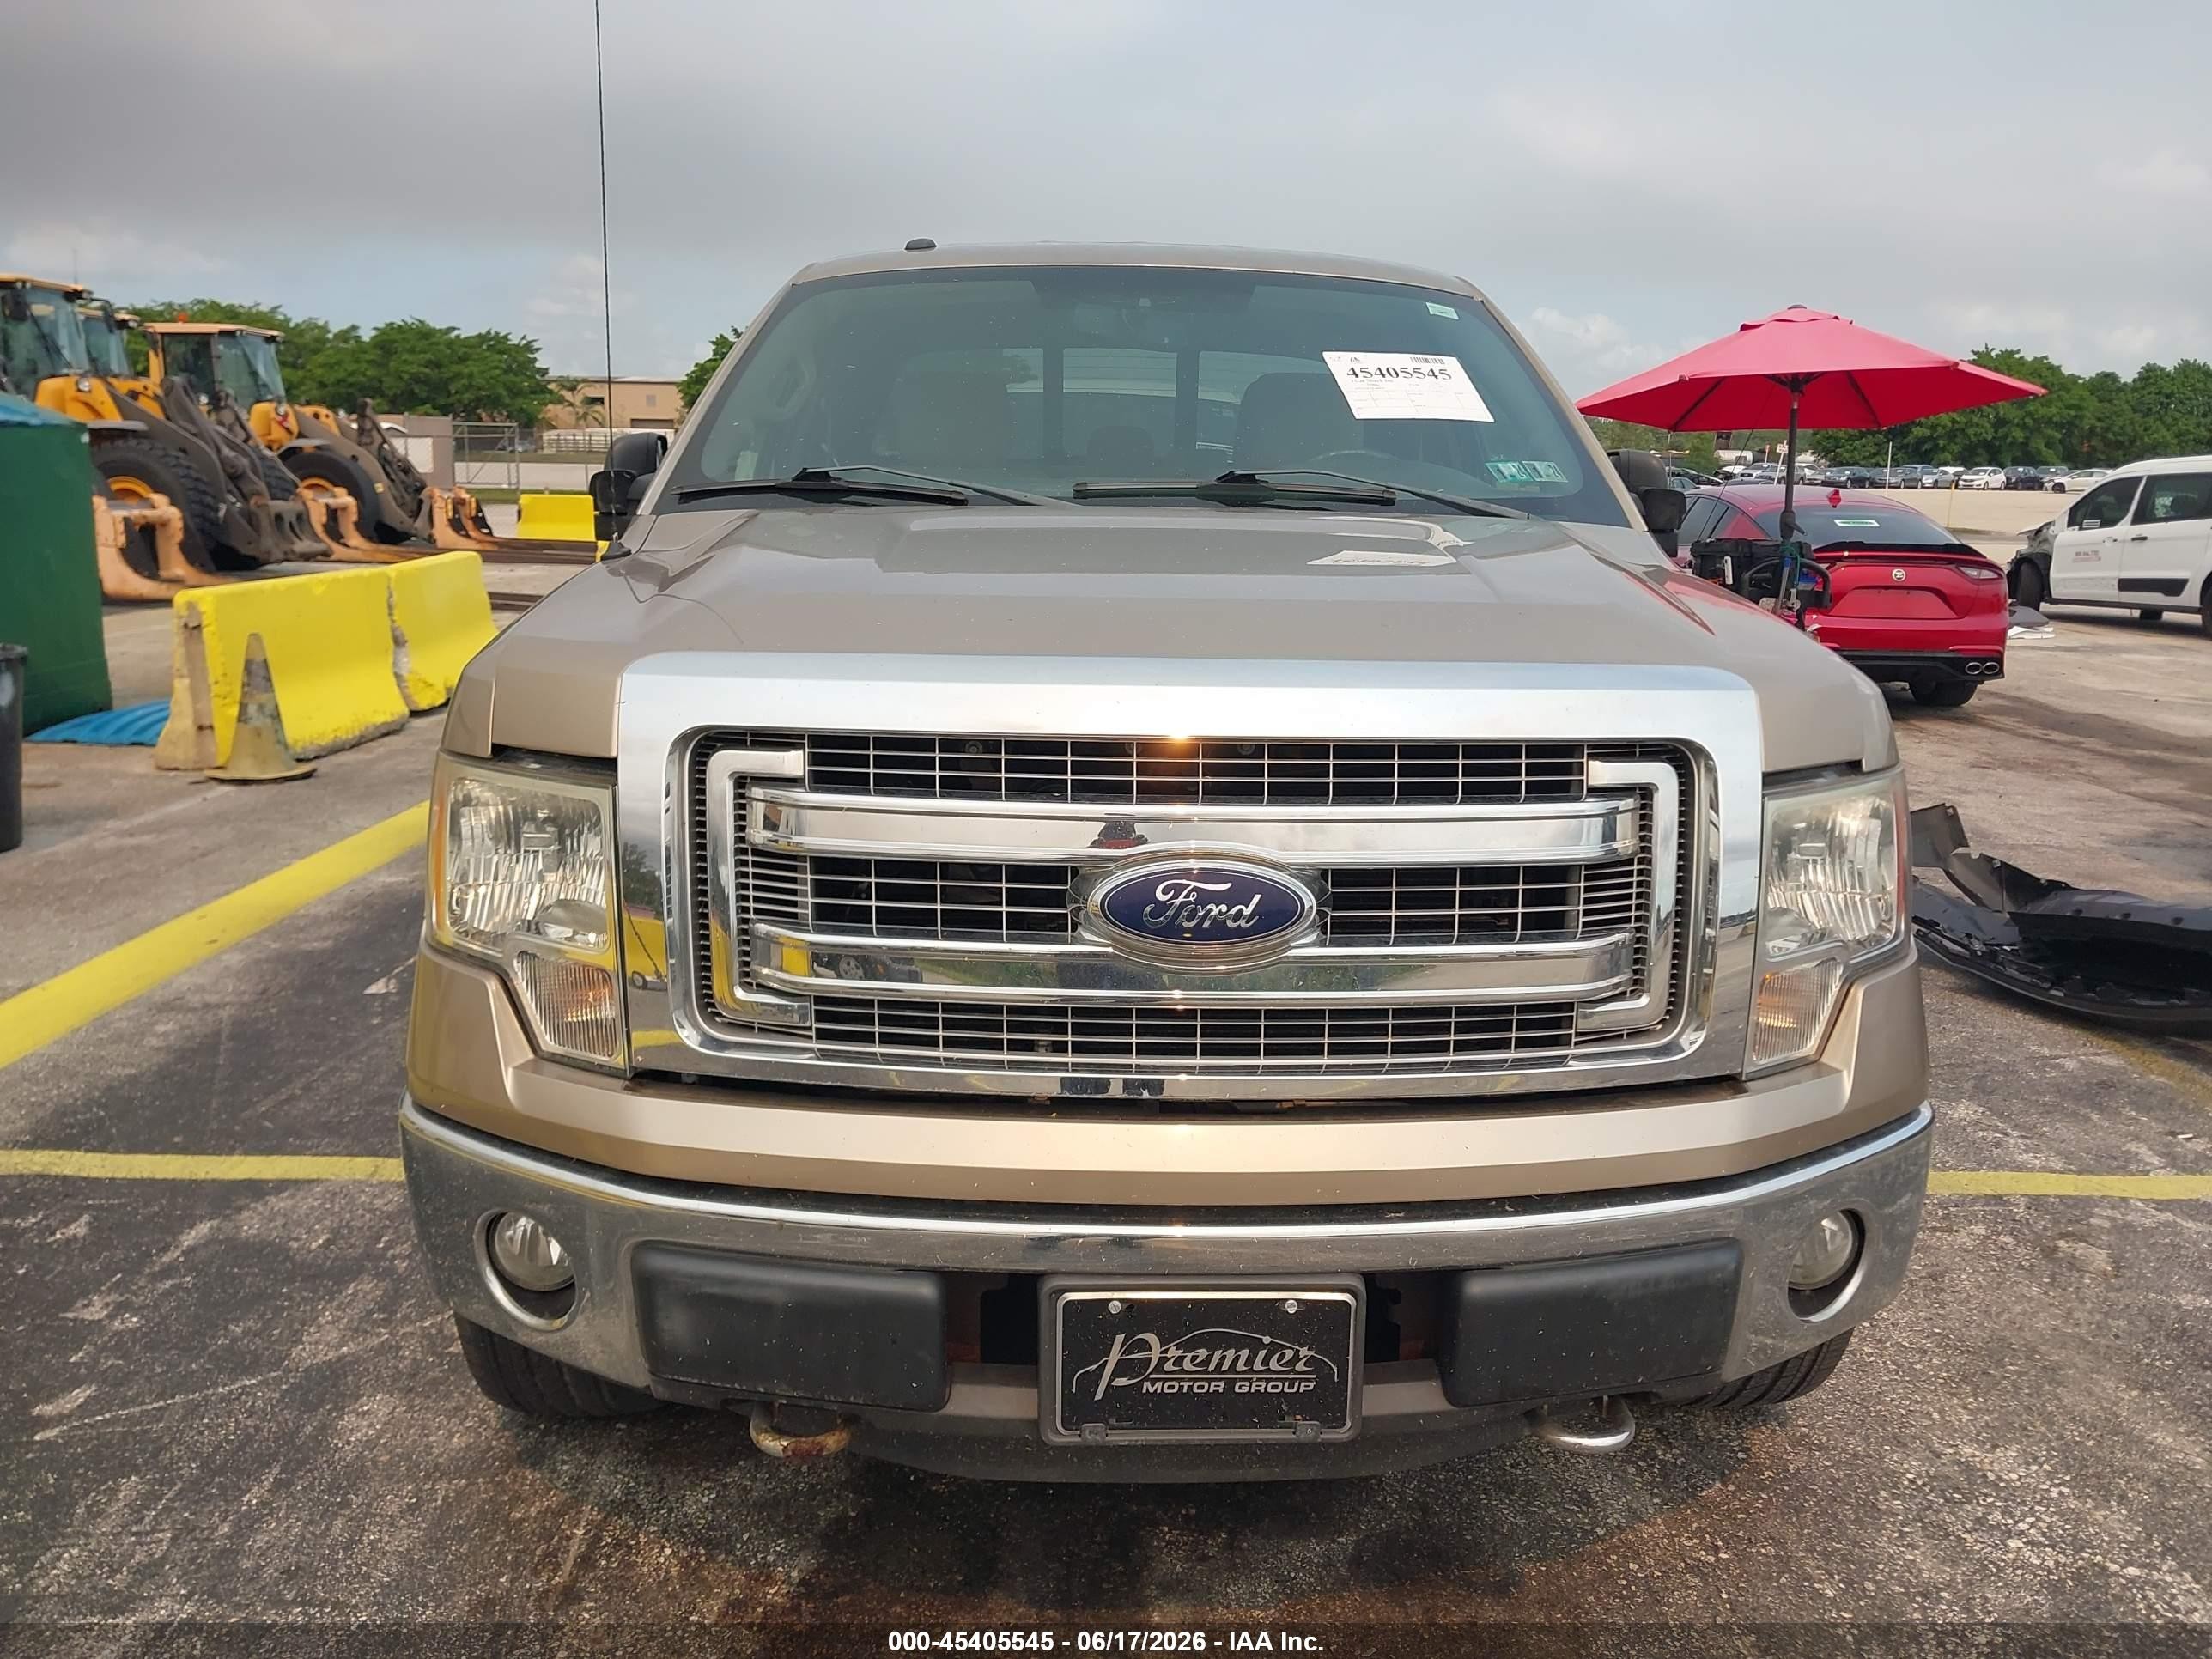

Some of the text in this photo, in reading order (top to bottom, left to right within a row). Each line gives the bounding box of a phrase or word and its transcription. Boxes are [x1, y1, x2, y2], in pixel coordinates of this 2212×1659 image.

[1346, 367, 1452, 380] 45405545
[1142, 879, 1262, 929] Ford
[1094, 1332, 1316, 1401] Premier
[1142, 1381, 1316, 1394] MOTOR GROUP
